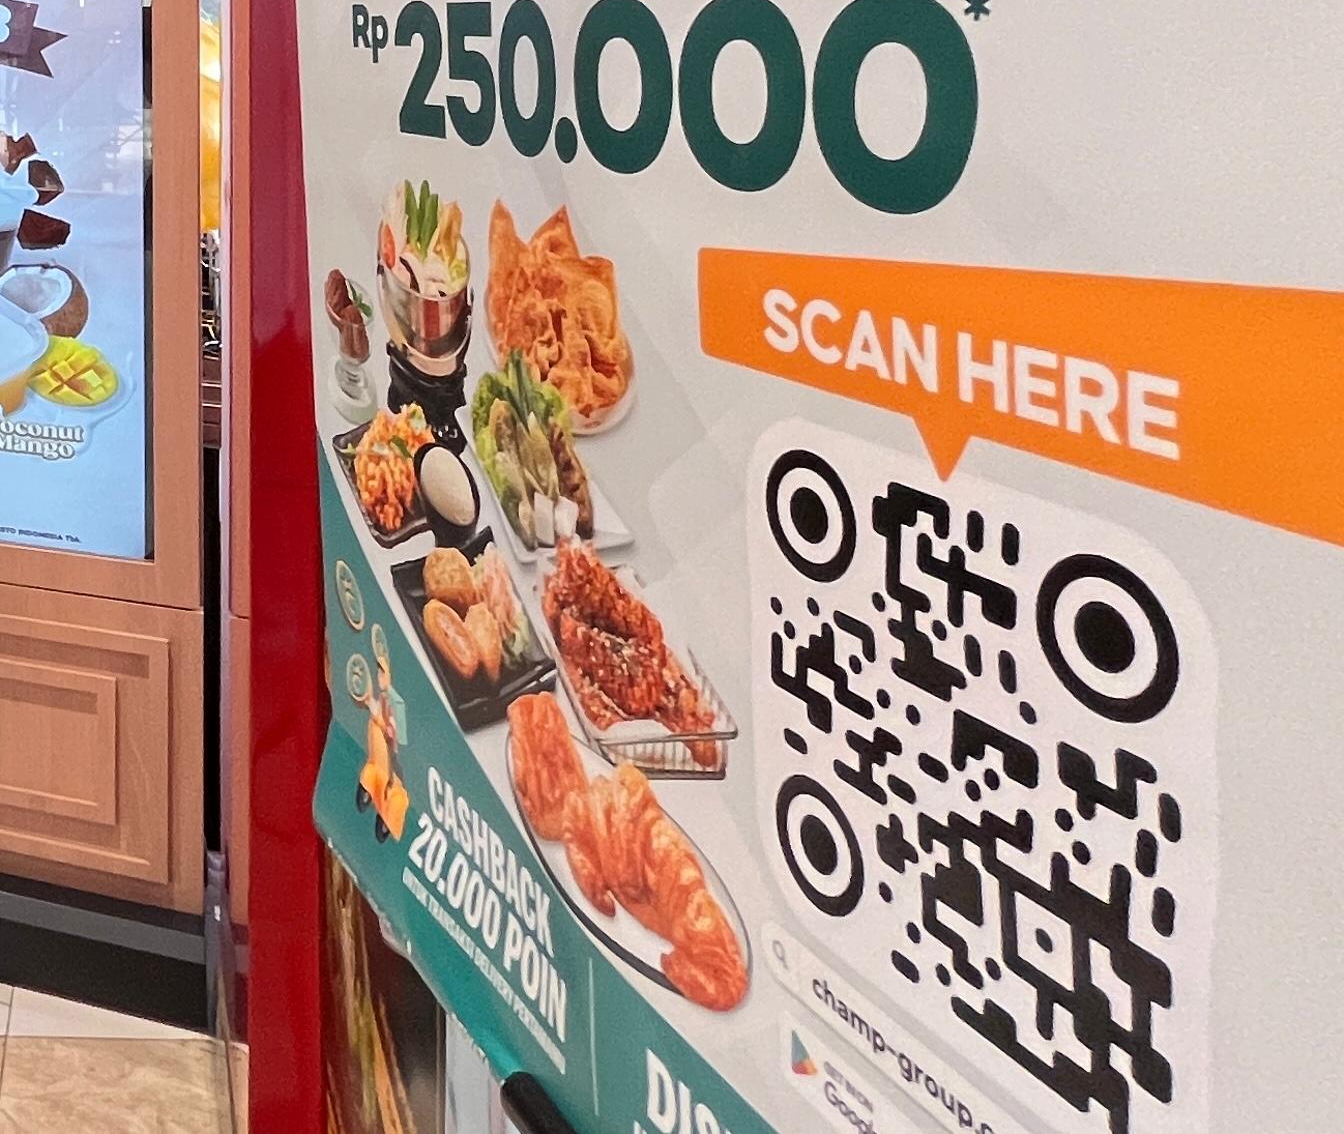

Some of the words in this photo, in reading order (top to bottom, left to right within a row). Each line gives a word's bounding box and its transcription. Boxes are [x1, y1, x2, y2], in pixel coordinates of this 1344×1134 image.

[762, 289, 938, 394] SCAN
[957, 331, 1180, 461] HERE
[408, 812, 501, 949] 20.000
[503, 912, 566, 1043] POIN
[427, 766, 554, 958] CASHBACK
